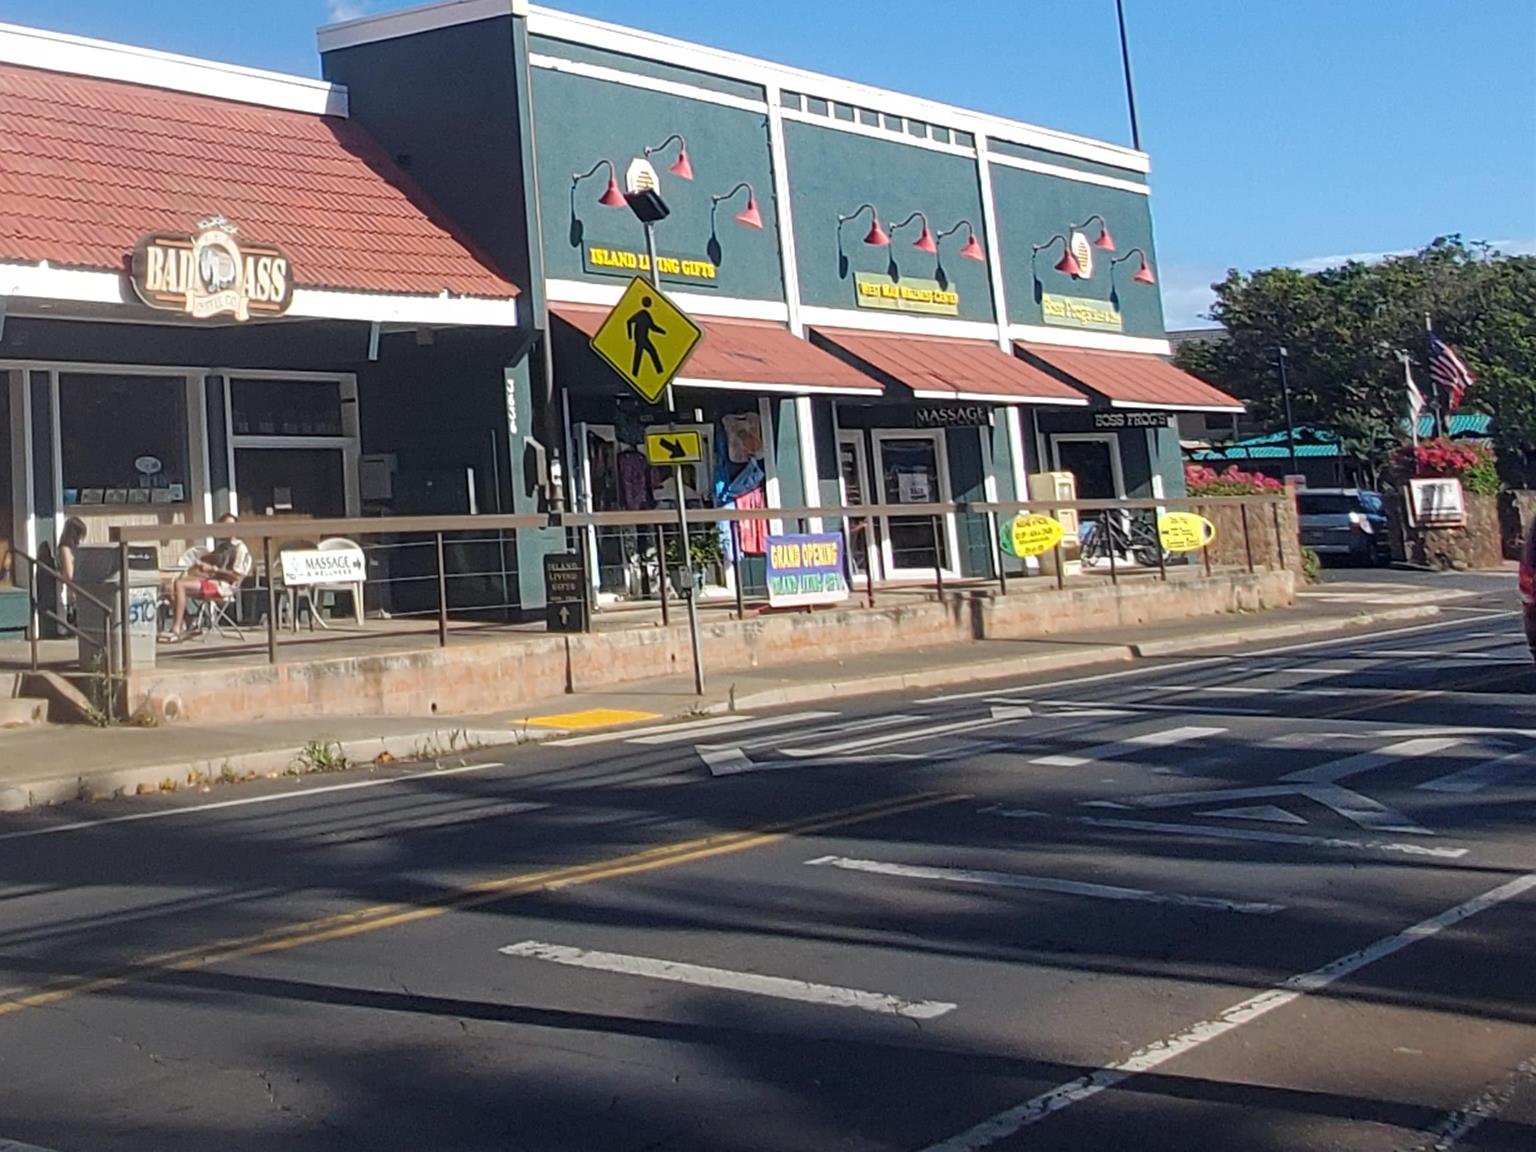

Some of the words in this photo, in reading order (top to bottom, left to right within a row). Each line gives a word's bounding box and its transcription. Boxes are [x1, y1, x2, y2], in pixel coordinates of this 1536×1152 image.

[590, 247, 637, 268] ISLAND
[681, 259, 716, 279] GIFTS
[146, 246, 194, 293] BAD
[243, 256, 287, 302] ASS
[916, 407, 985, 422] MASSAGE
[1094, 413, 1124, 427] BOSS
[305, 556, 350, 570] MASSAGE
[770, 543, 801, 569] GRAND
[802, 541, 837, 567] OPENING
